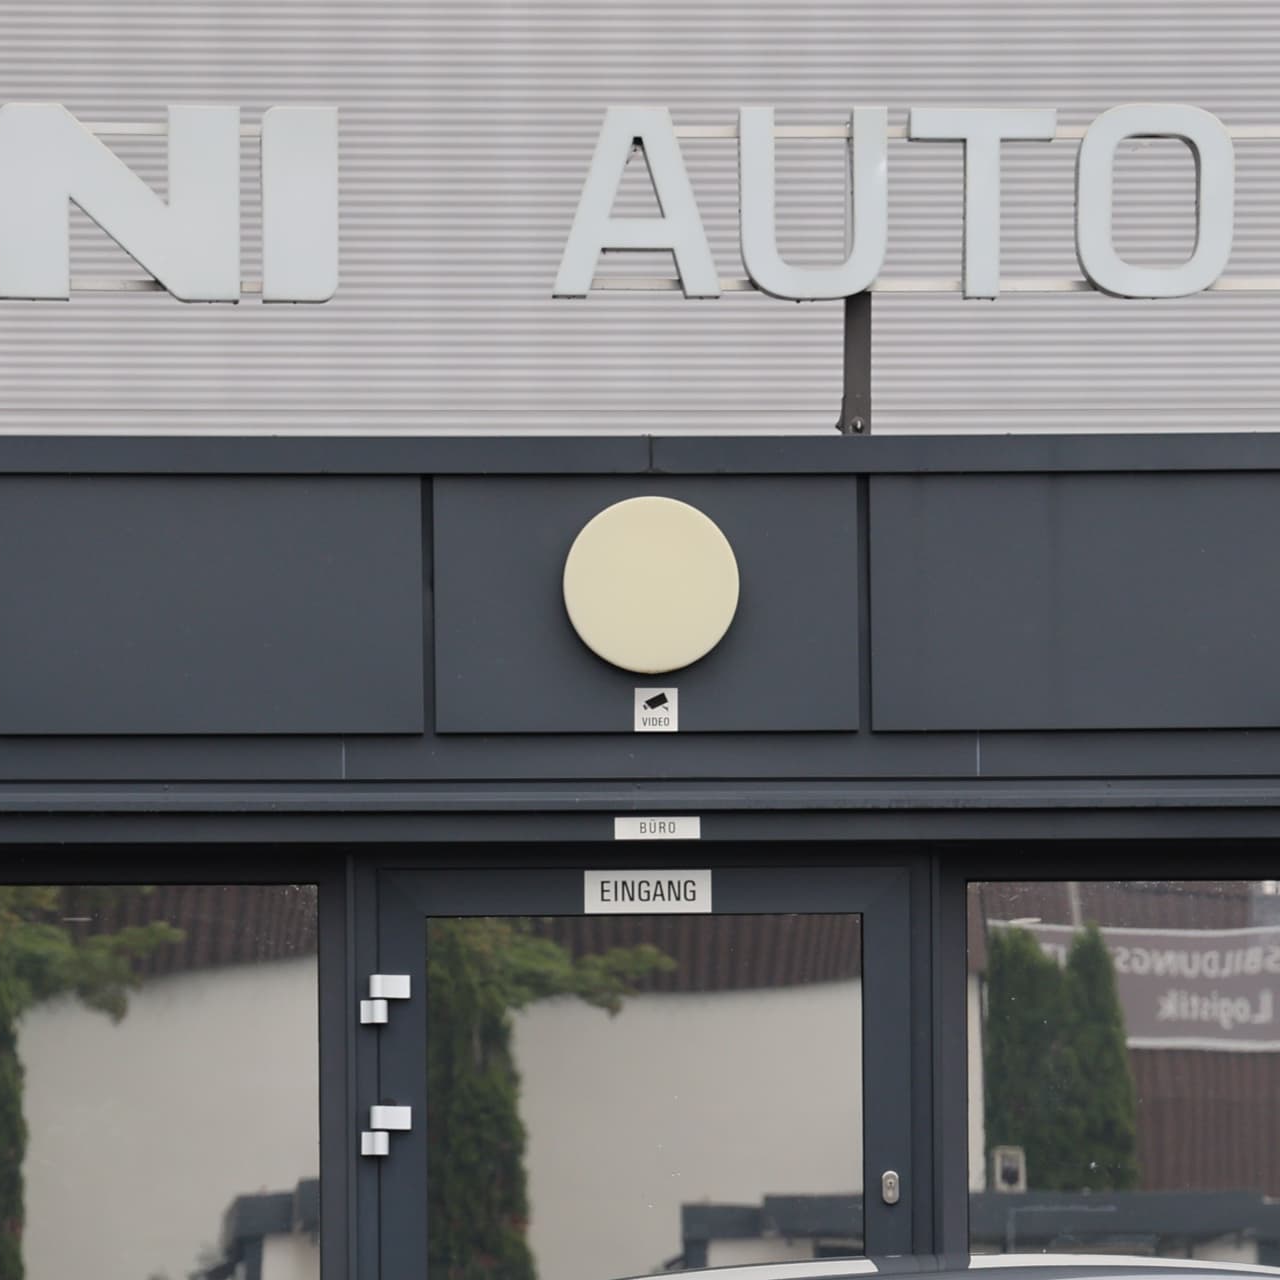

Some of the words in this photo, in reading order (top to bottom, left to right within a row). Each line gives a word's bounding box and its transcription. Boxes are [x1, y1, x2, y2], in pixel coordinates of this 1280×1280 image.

[552, 102, 1236, 302] AUTO
[642, 717, 670, 727] VIDEO
[640, 818, 676, 834] BÜRO
[600, 880, 696, 902] EINGANG
